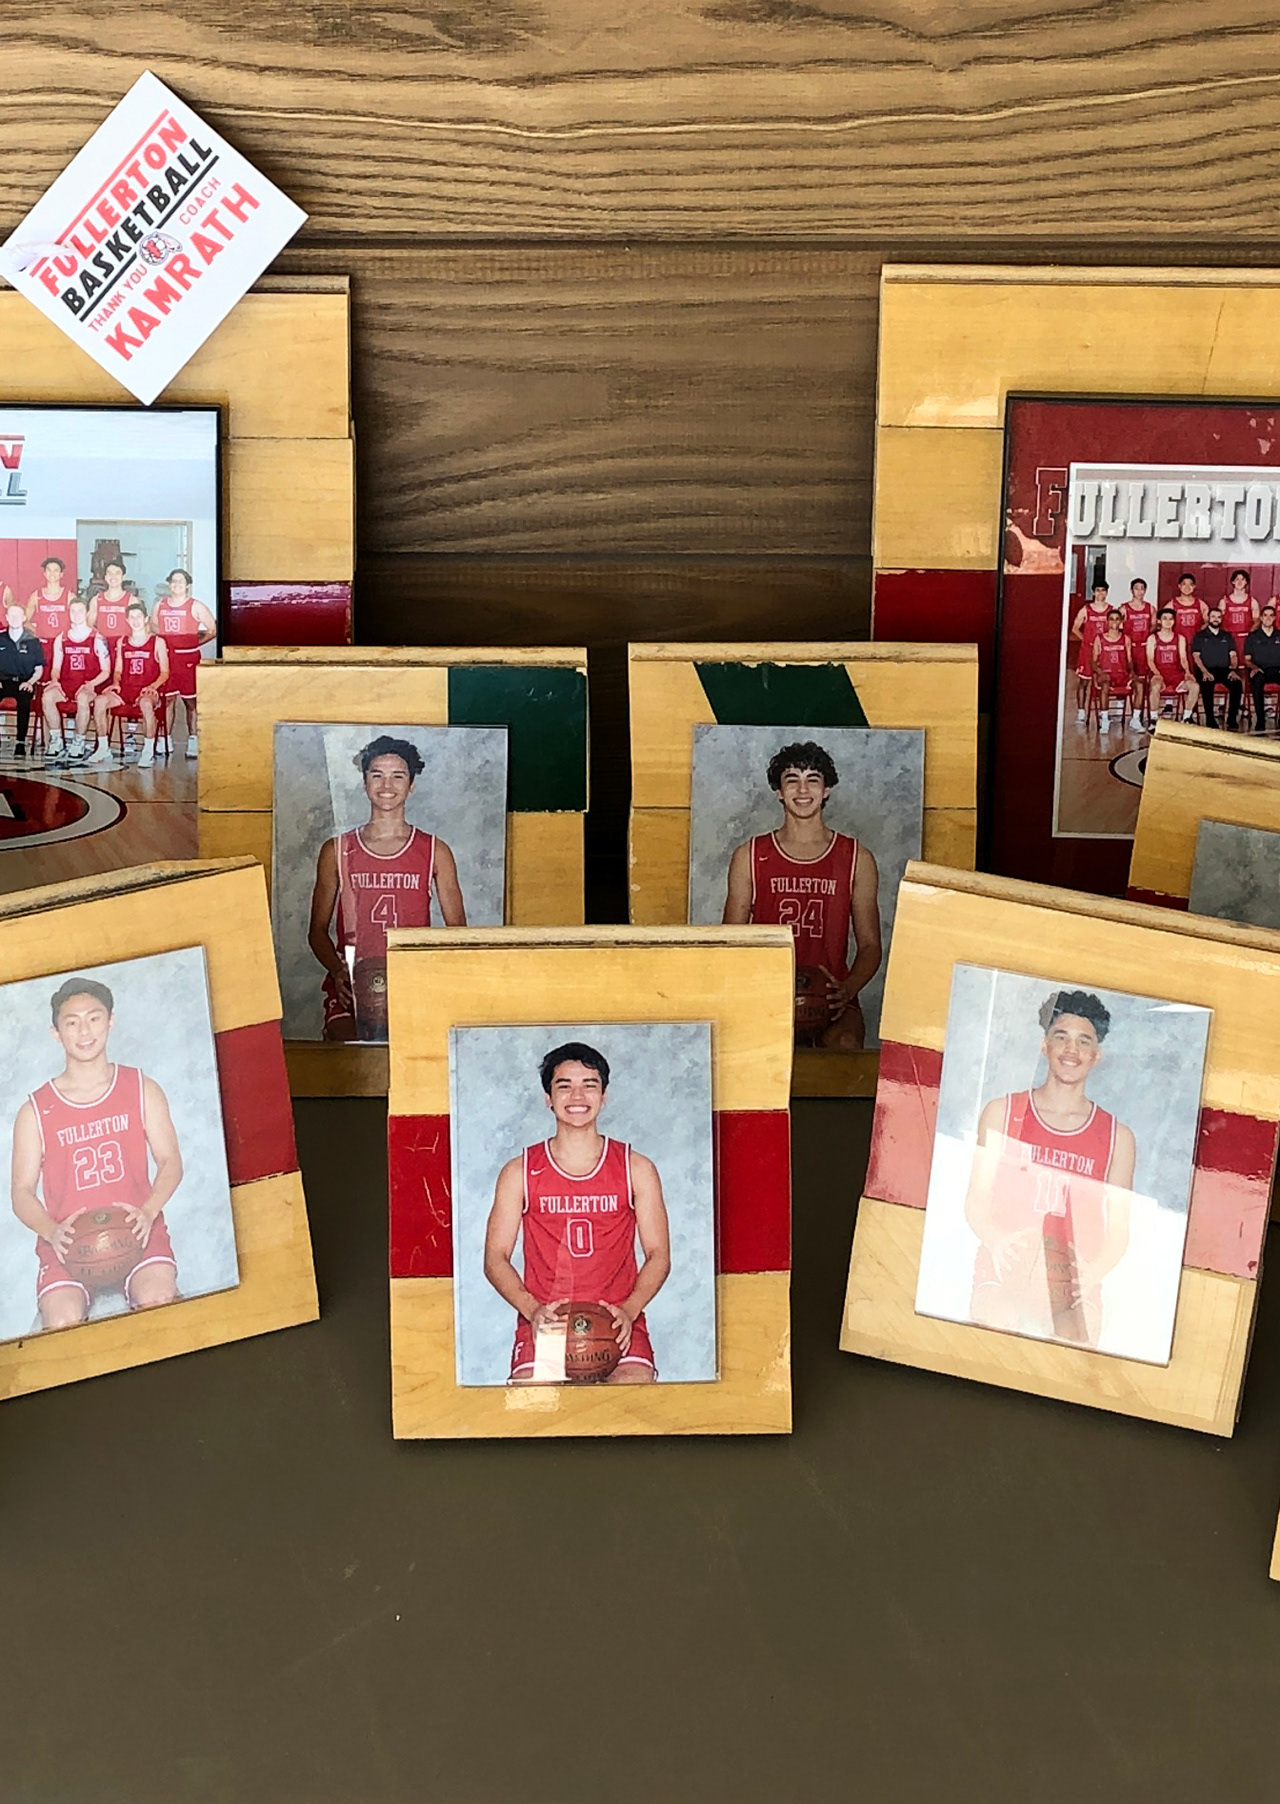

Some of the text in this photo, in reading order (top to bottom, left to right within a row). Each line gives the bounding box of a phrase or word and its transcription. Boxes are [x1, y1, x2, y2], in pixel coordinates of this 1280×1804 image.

[38, 116, 189, 297] FULLERTON
[60, 138, 213, 316] BASKETBALL
[88, 177, 222, 333] THANK YOU COACH
[104, 182, 261, 361] KAMRATH
[351, 873, 420, 890] FULLERTON
[770, 877, 837, 896] FULLERTON
[371, 894, 398, 937] 4
[779, 899, 824, 938] 24
[56, 1113, 130, 1148] FULLERTON
[73, 1140, 125, 1191] 23
[1019, 1141, 1096, 1176] FULLERTON
[539, 1194, 618, 1214] FULLERTON
[1033, 1170, 1070, 1218] 11
[567, 1218, 594, 1258] 0
